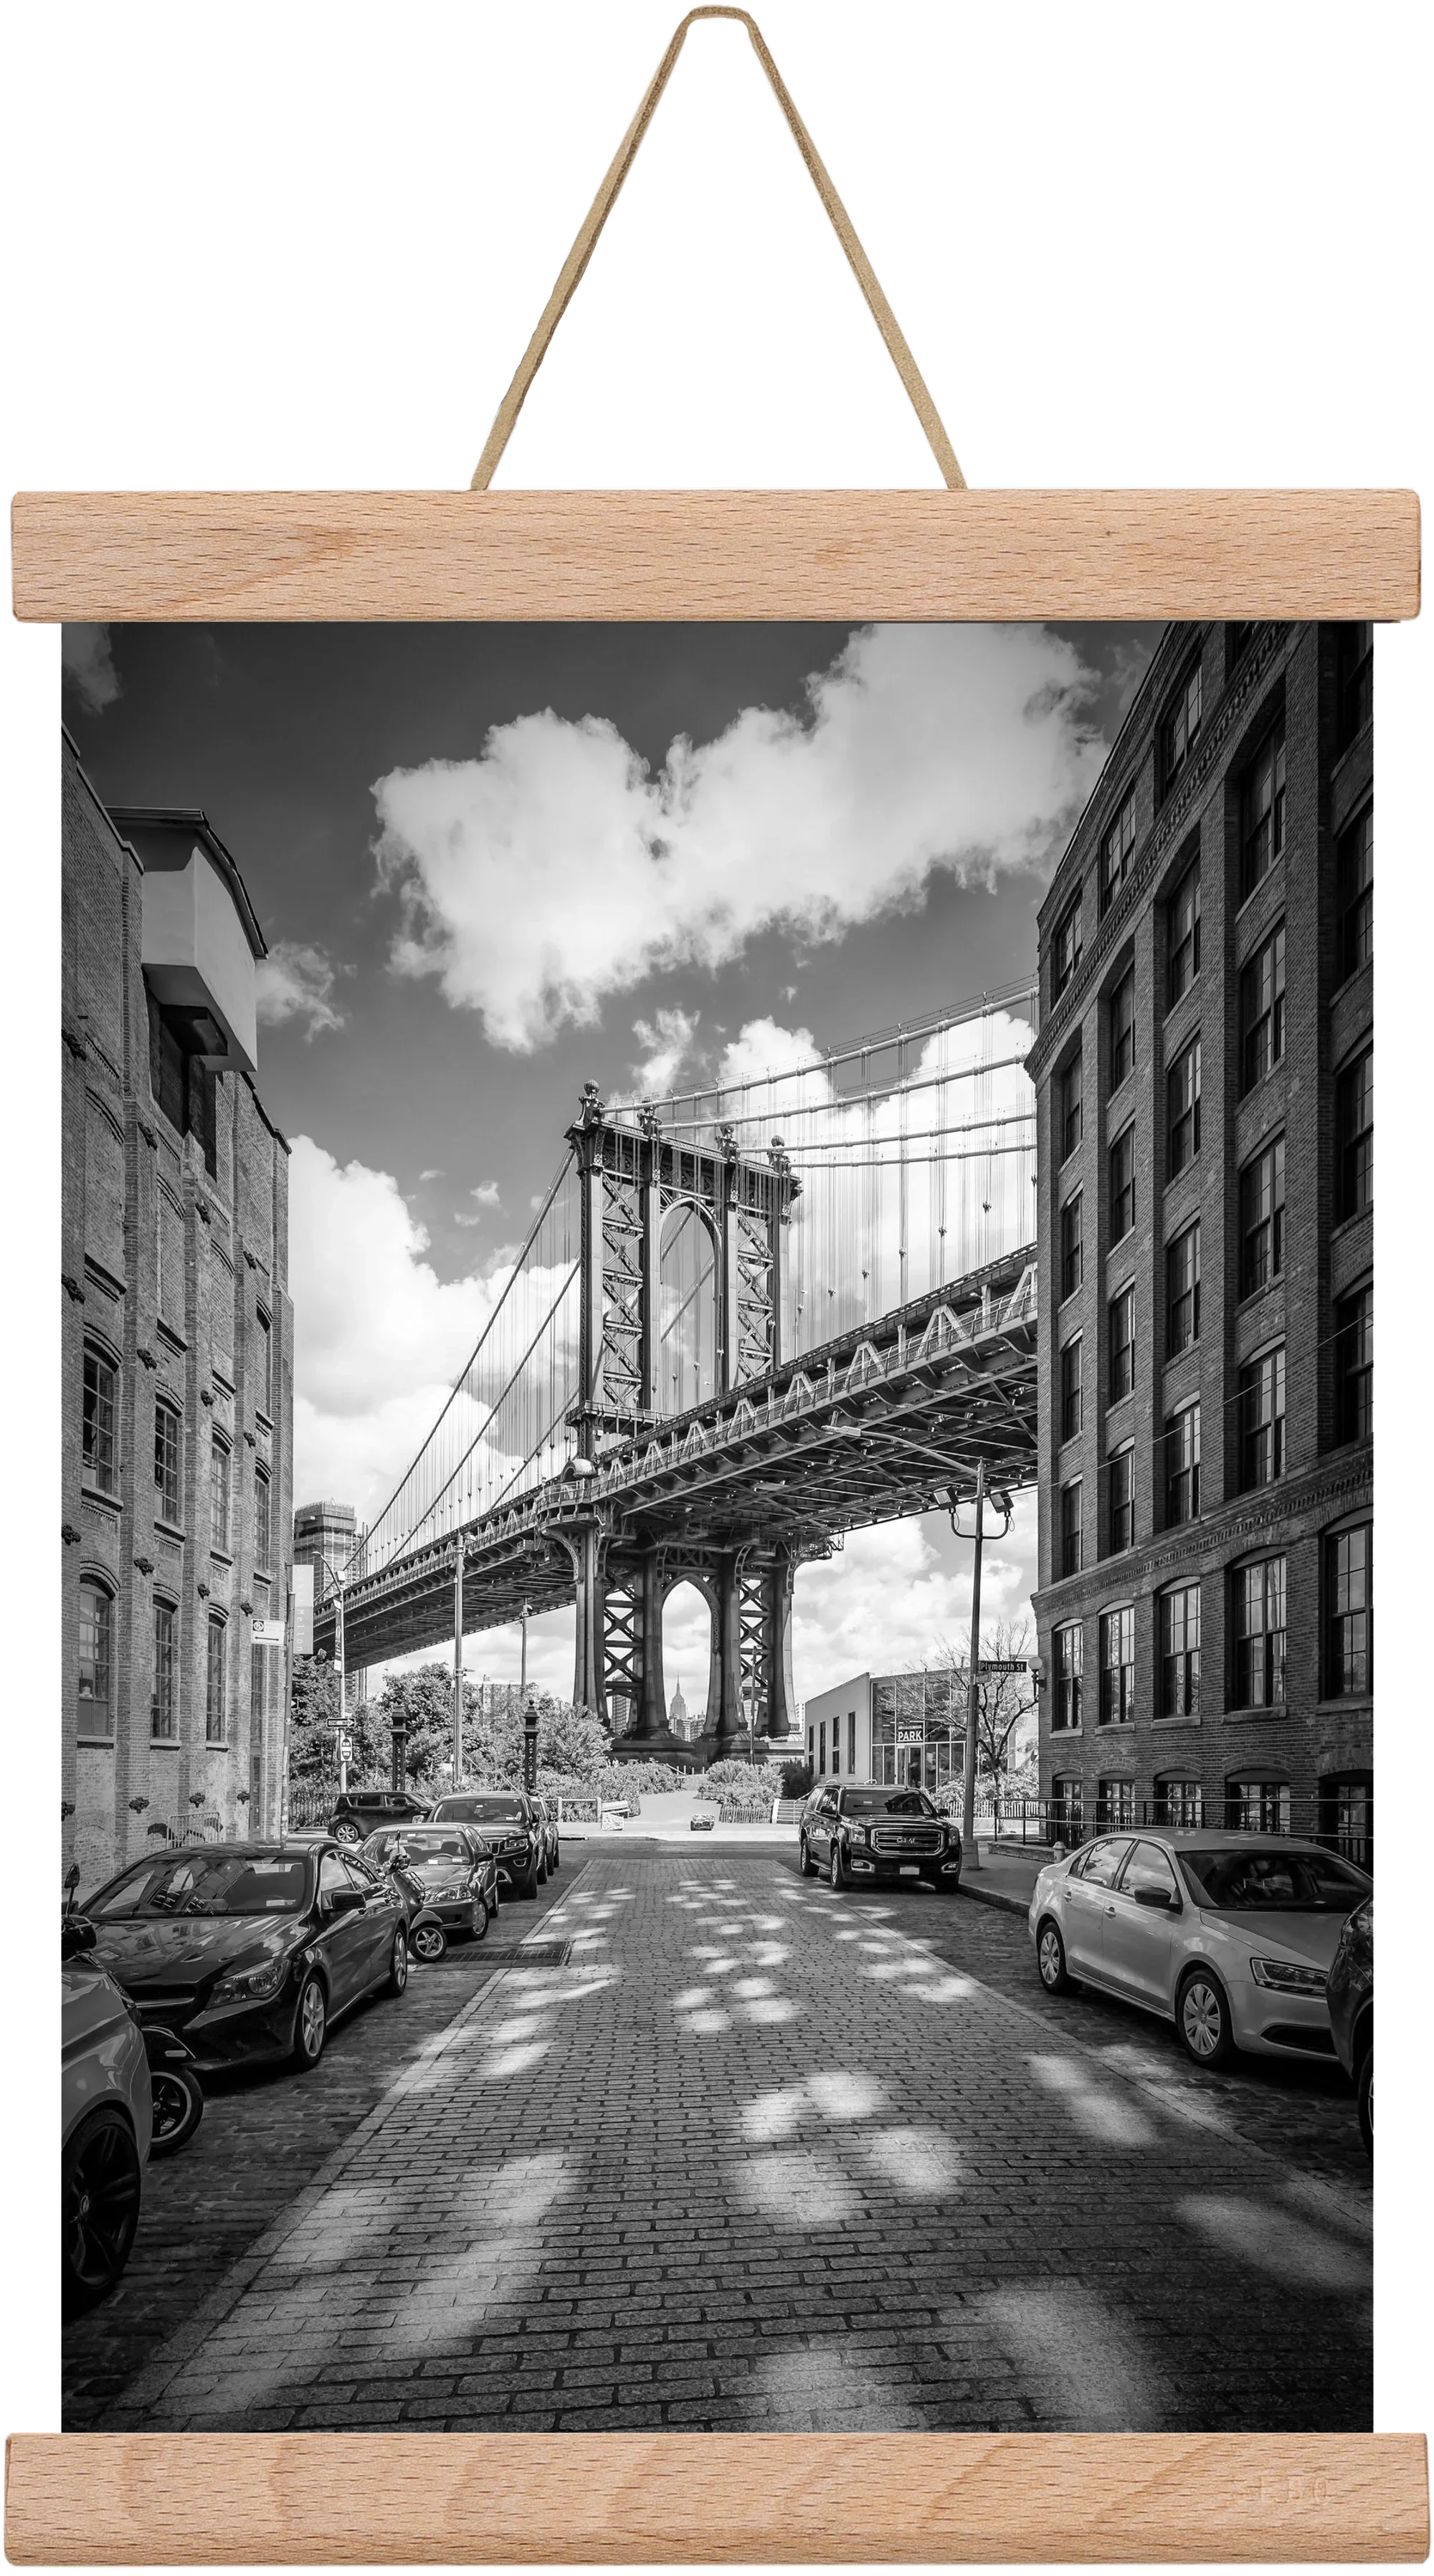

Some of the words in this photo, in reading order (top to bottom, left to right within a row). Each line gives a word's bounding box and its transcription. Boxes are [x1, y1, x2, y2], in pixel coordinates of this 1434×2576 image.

[297, 1609, 305, 1652] Mellon
[981, 1662, 1015, 1671] Plymouth
[1016, 1663, 1024, 1671] St
[898, 1731, 923, 1741] PARK
